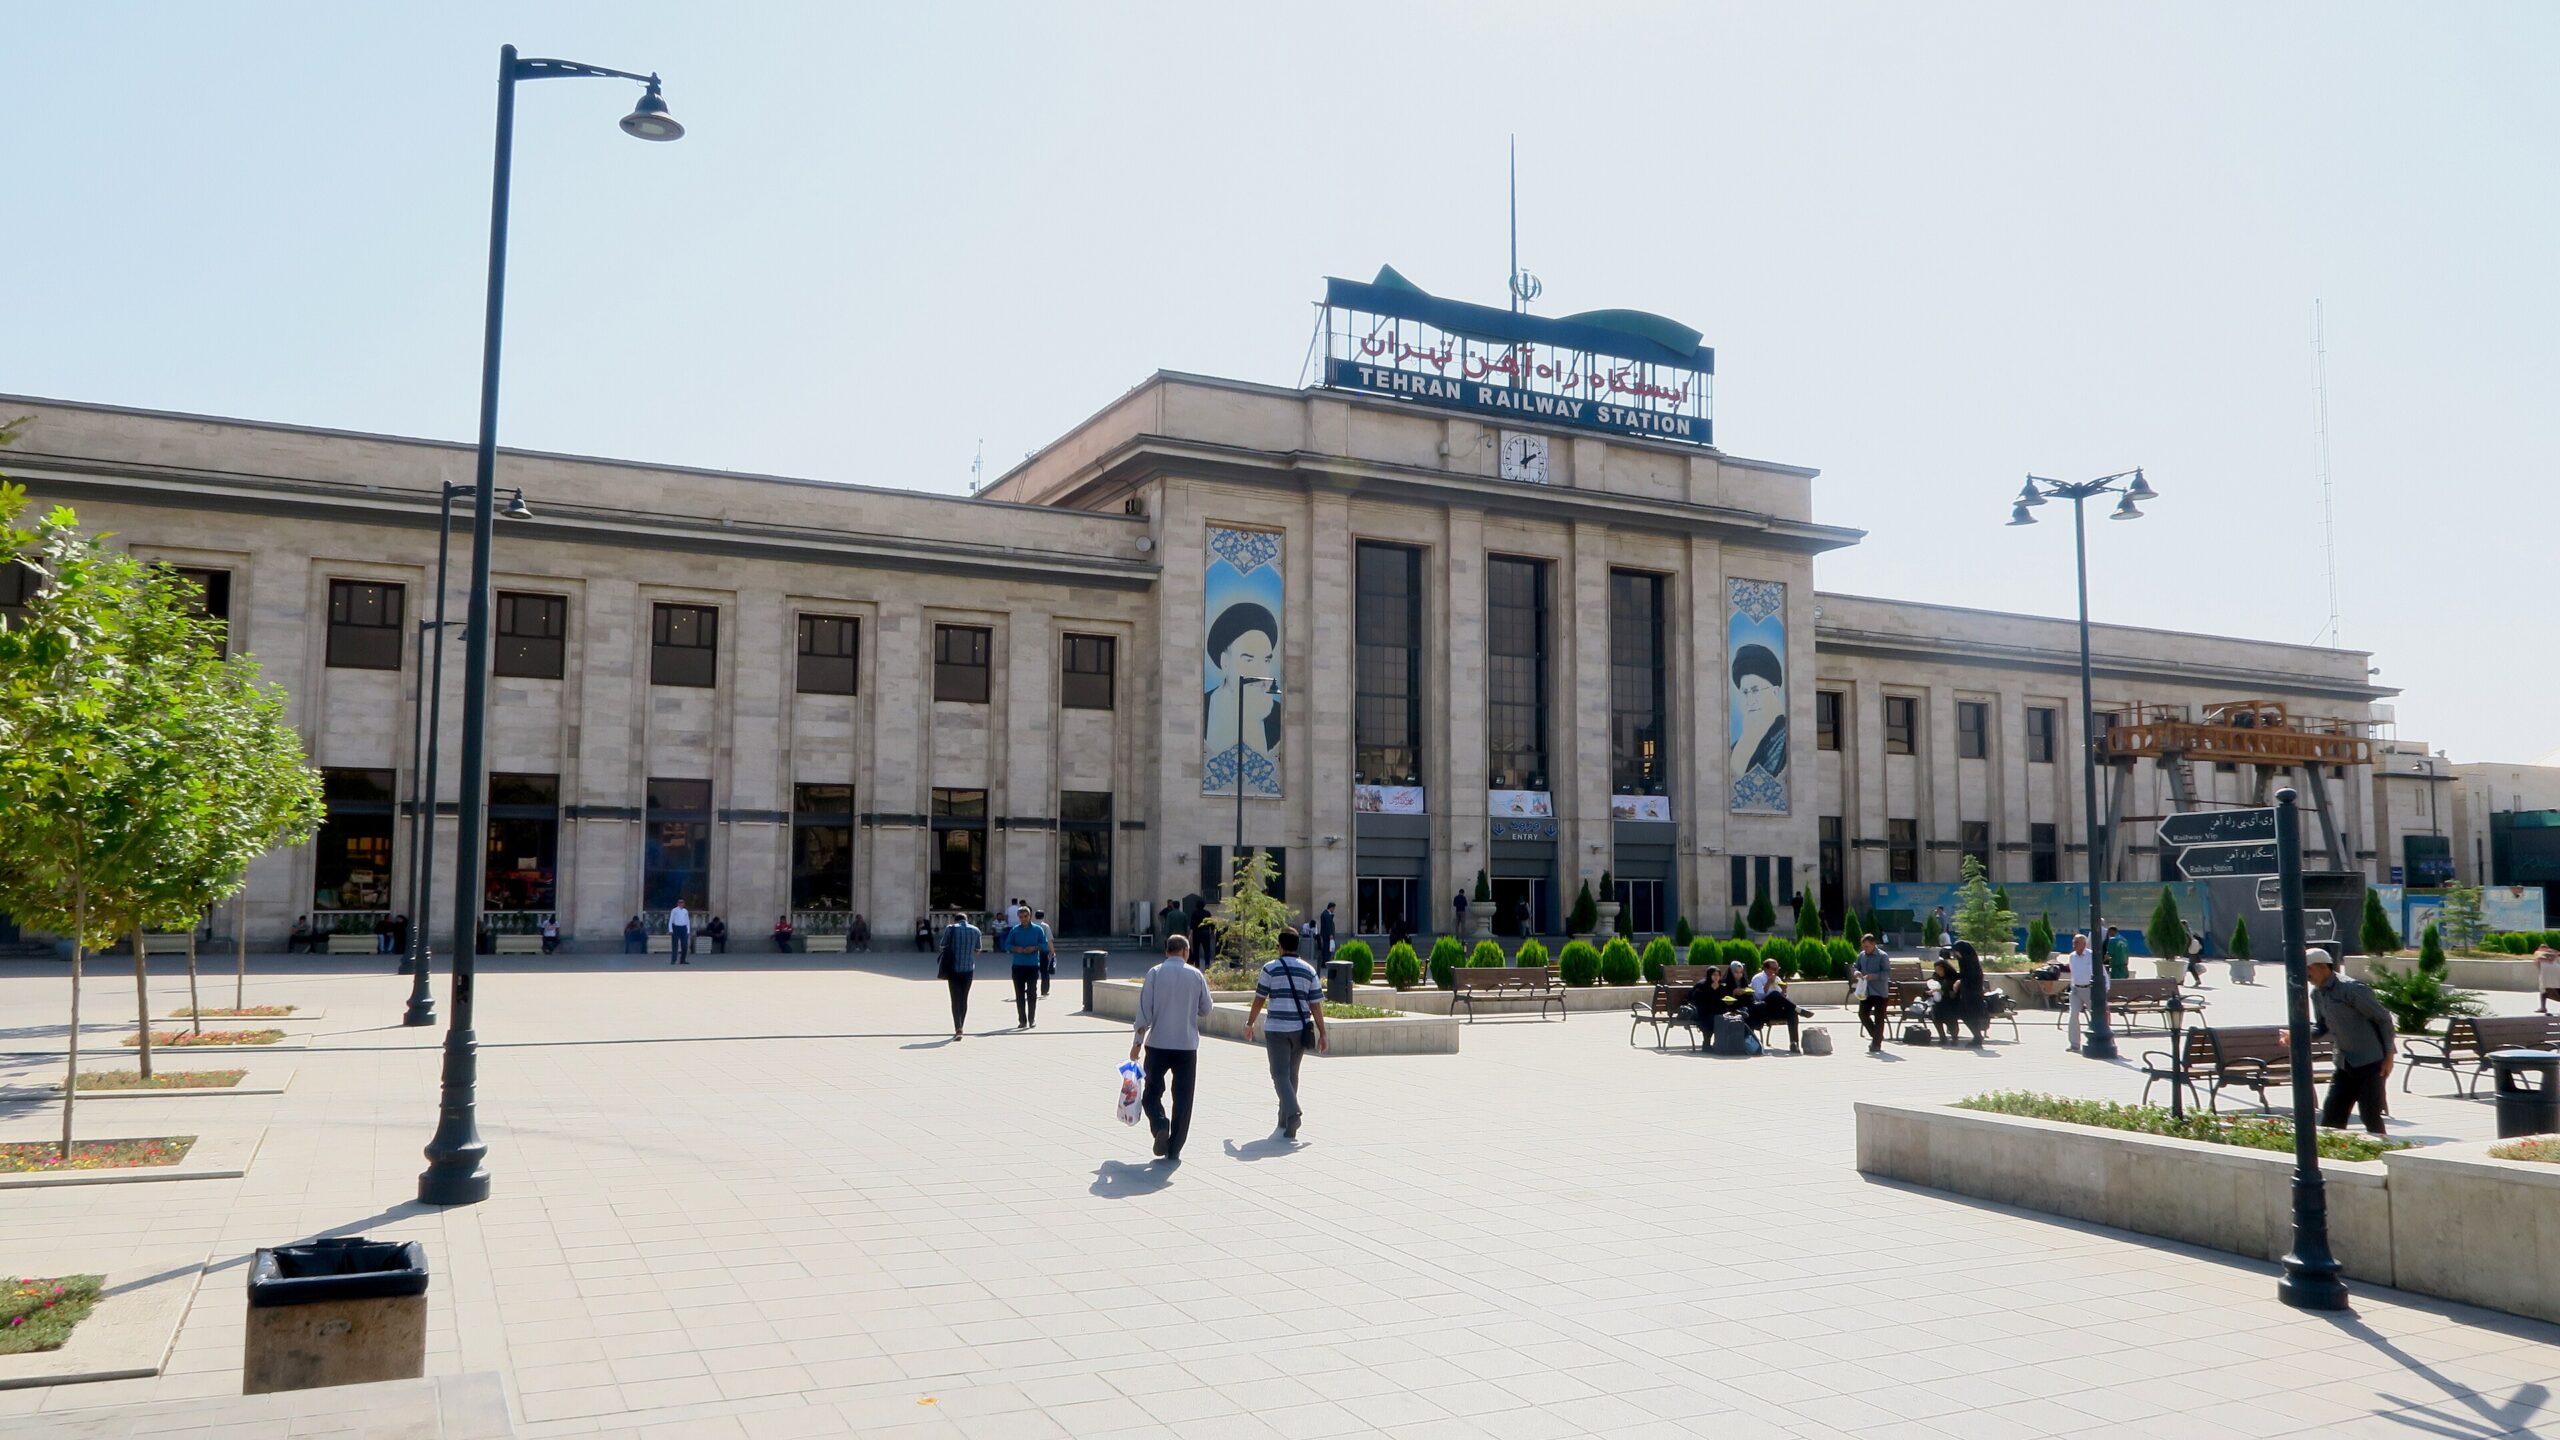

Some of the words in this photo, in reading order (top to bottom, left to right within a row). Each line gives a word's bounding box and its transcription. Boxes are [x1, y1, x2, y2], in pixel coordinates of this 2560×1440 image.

[1360, 330, 1453, 372] تهران
[1462, 346, 1535, 379] آهن
[1536, 359, 1580, 390] راه
[1589, 364, 1689, 408] ایستگاه
[1358, 366, 1461, 400] TEHRAN
[1478, 386, 1584, 420] RAILWAY
[1597, 405, 1690, 436] STATION
